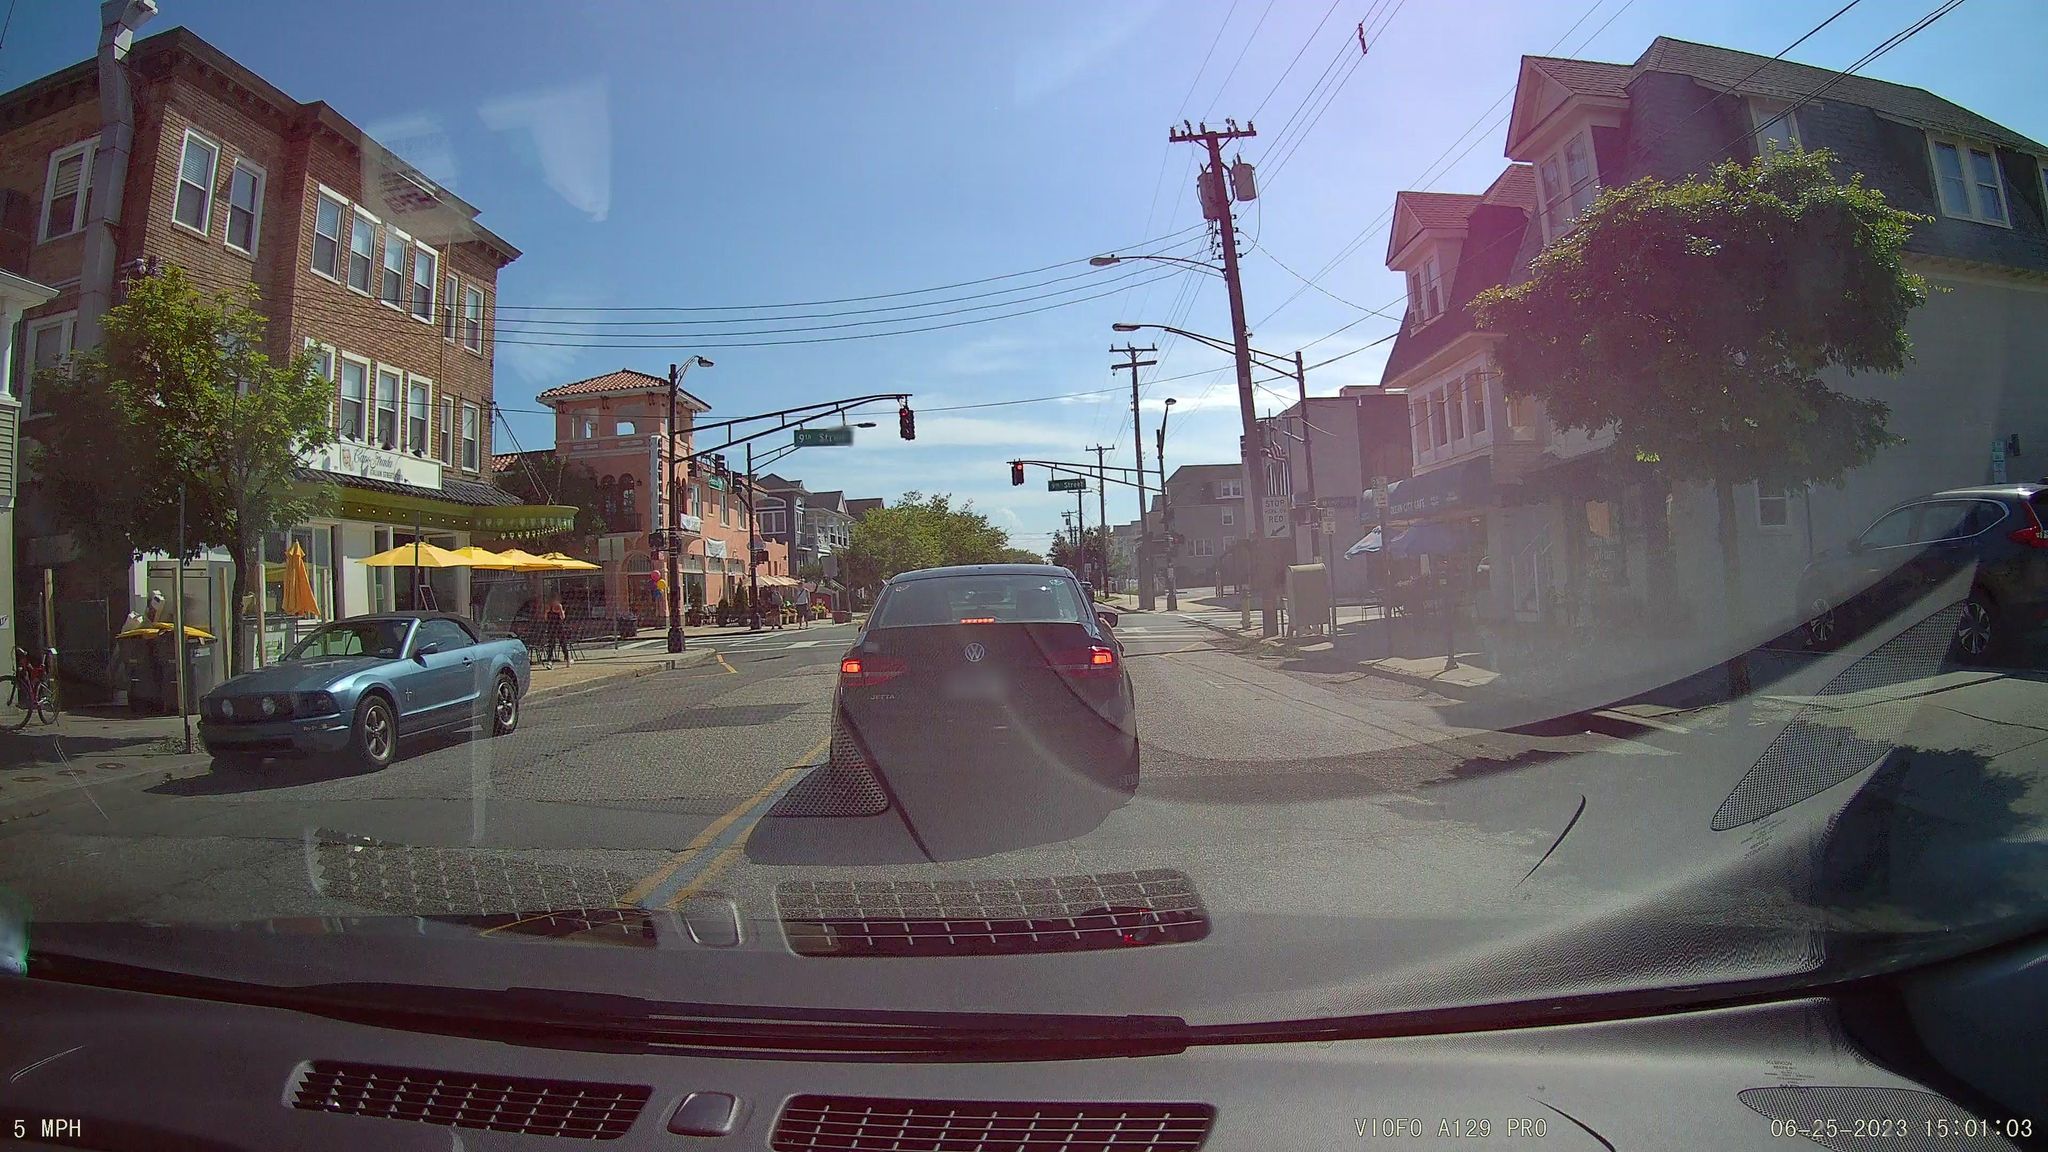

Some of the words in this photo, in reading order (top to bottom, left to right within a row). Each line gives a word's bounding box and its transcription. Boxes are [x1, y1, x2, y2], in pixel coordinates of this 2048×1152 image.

[1063, 481, 1084, 489] Street
[1265, 499, 1285, 508] STOP
[1269, 515, 1284, 523] RED
